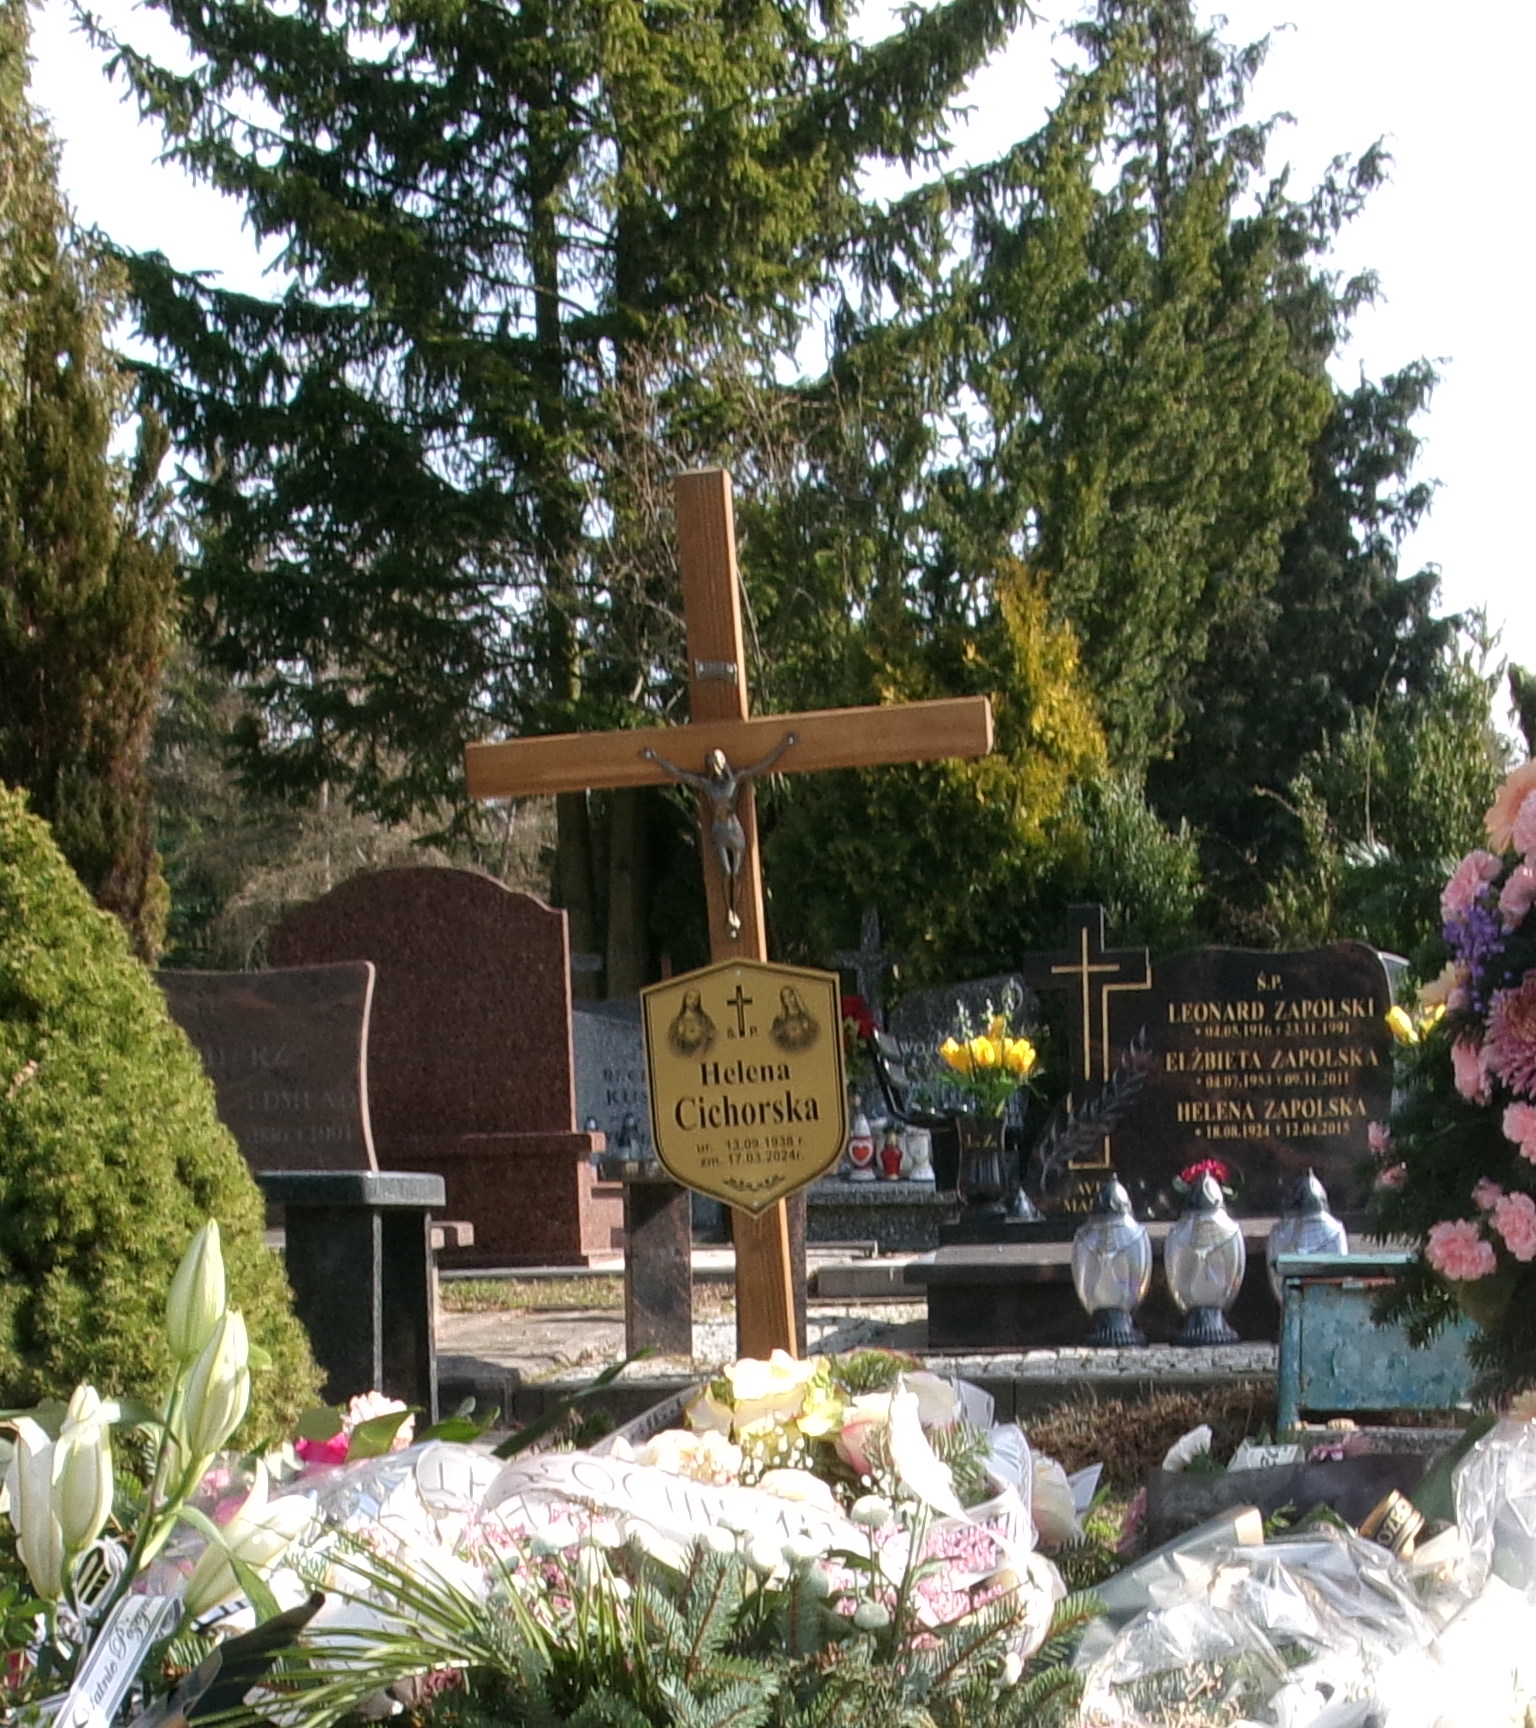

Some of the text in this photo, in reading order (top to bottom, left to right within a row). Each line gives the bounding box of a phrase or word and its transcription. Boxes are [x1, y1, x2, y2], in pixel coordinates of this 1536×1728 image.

[1168, 997, 1375, 1023] LEONARD ZAPOLSKI
[700, 1059, 791, 1086] Helena
[1165, 1047, 1379, 1072] ELŻBIETA ZAPOLSKA
[674, 1090, 819, 1132] Cichorska
[1176, 1097, 1367, 1122] HELENA ZAPOLSKA
